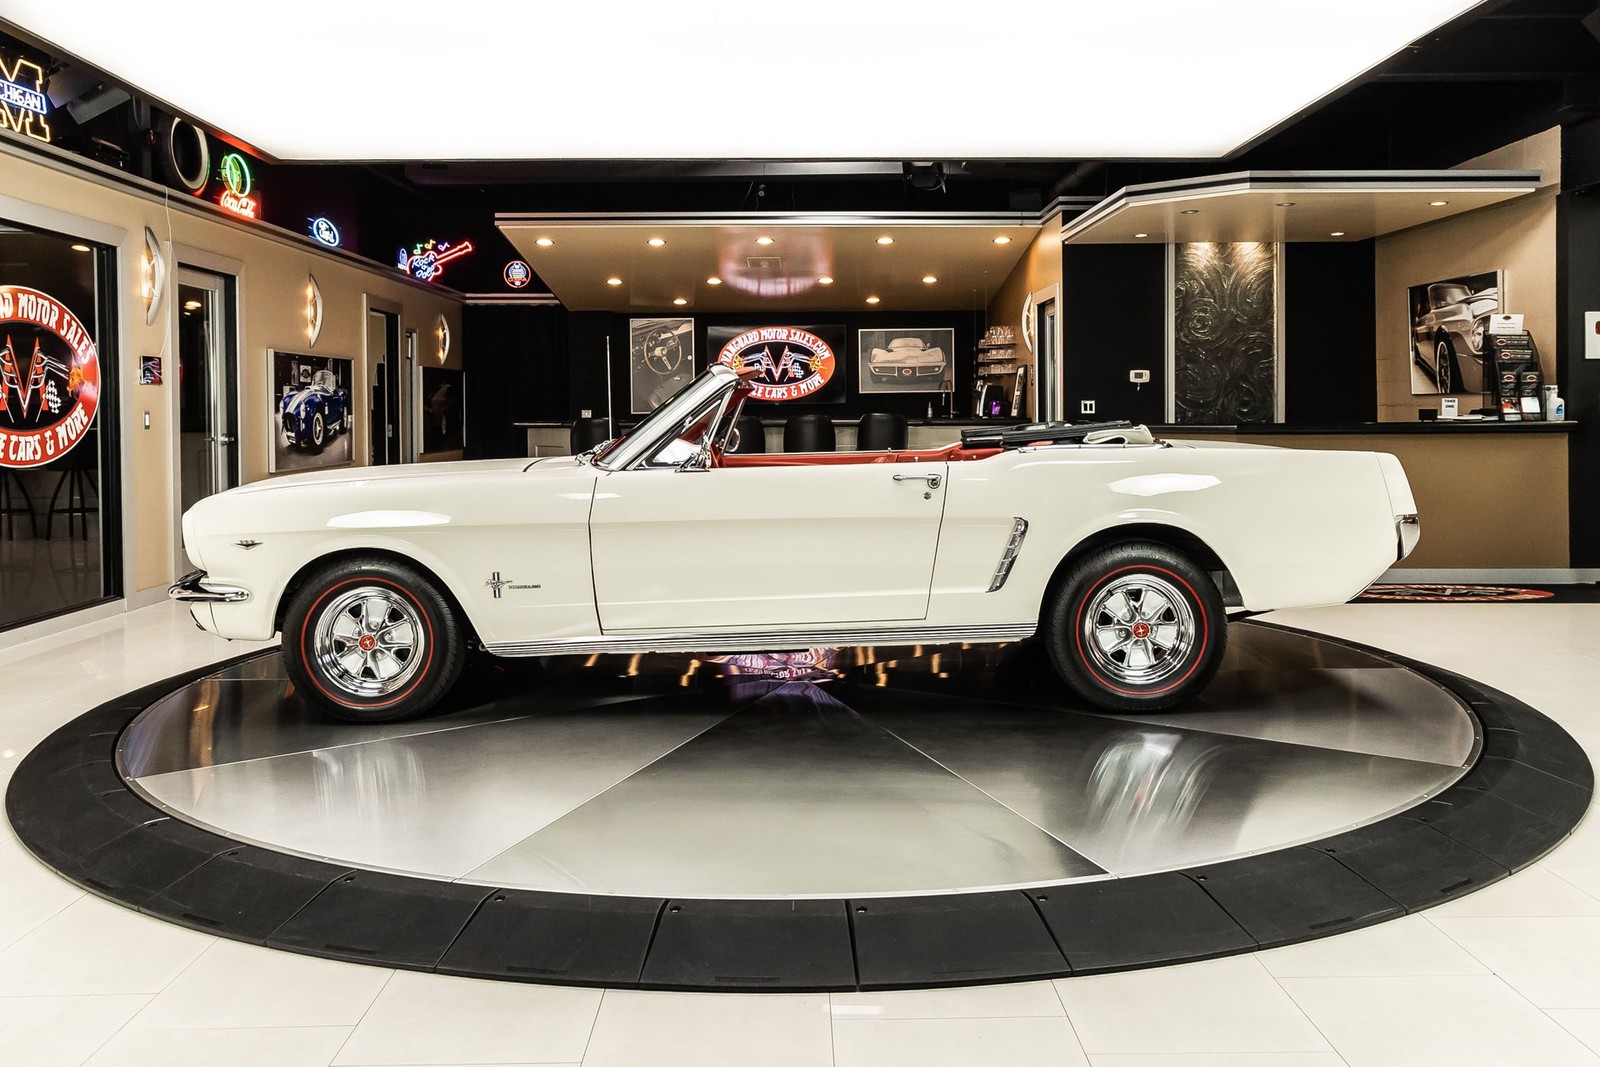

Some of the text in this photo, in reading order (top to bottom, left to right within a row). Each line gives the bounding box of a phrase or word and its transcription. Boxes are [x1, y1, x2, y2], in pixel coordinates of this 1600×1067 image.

[17, 292, 60, 330] MOTOR
[60, 313, 95, 364] SALES
[720, 331, 759, 365] VANGUARD
[760, 328, 787, 340] MOTOR
[765, 387, 788, 399] CARS
[800, 374, 825, 394] MORE
[9, 434, 42, 461] CARS
[44, 430, 56, 455] &
[55, 402, 89, 450] MORE
